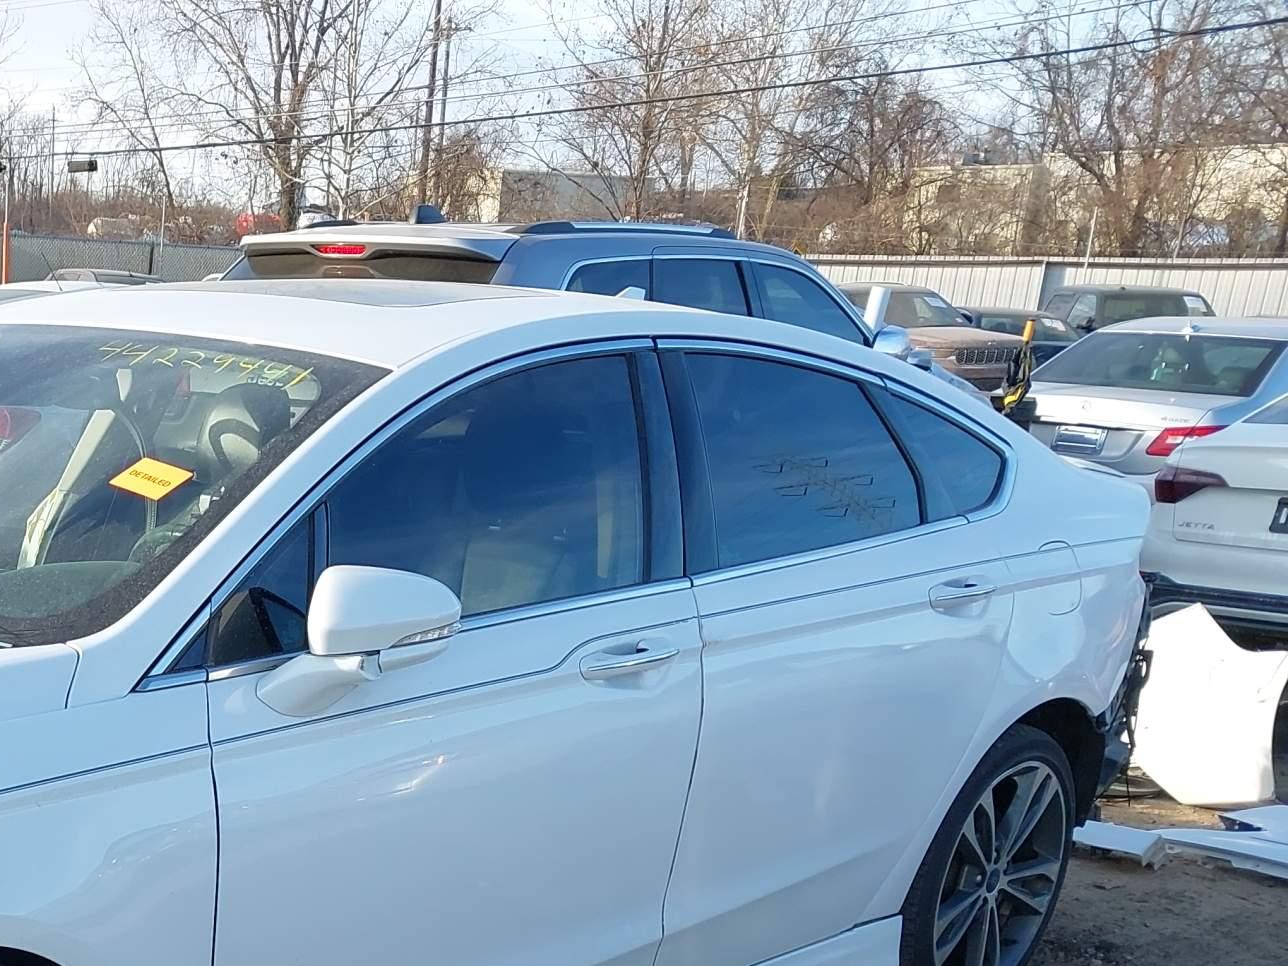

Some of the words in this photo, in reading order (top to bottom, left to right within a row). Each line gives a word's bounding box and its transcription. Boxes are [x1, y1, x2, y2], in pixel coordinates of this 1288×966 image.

[98, 339, 315, 391] 44229441
[128, 469, 172, 488] DETAILED
[1177, 520, 1216, 531] JETTA
